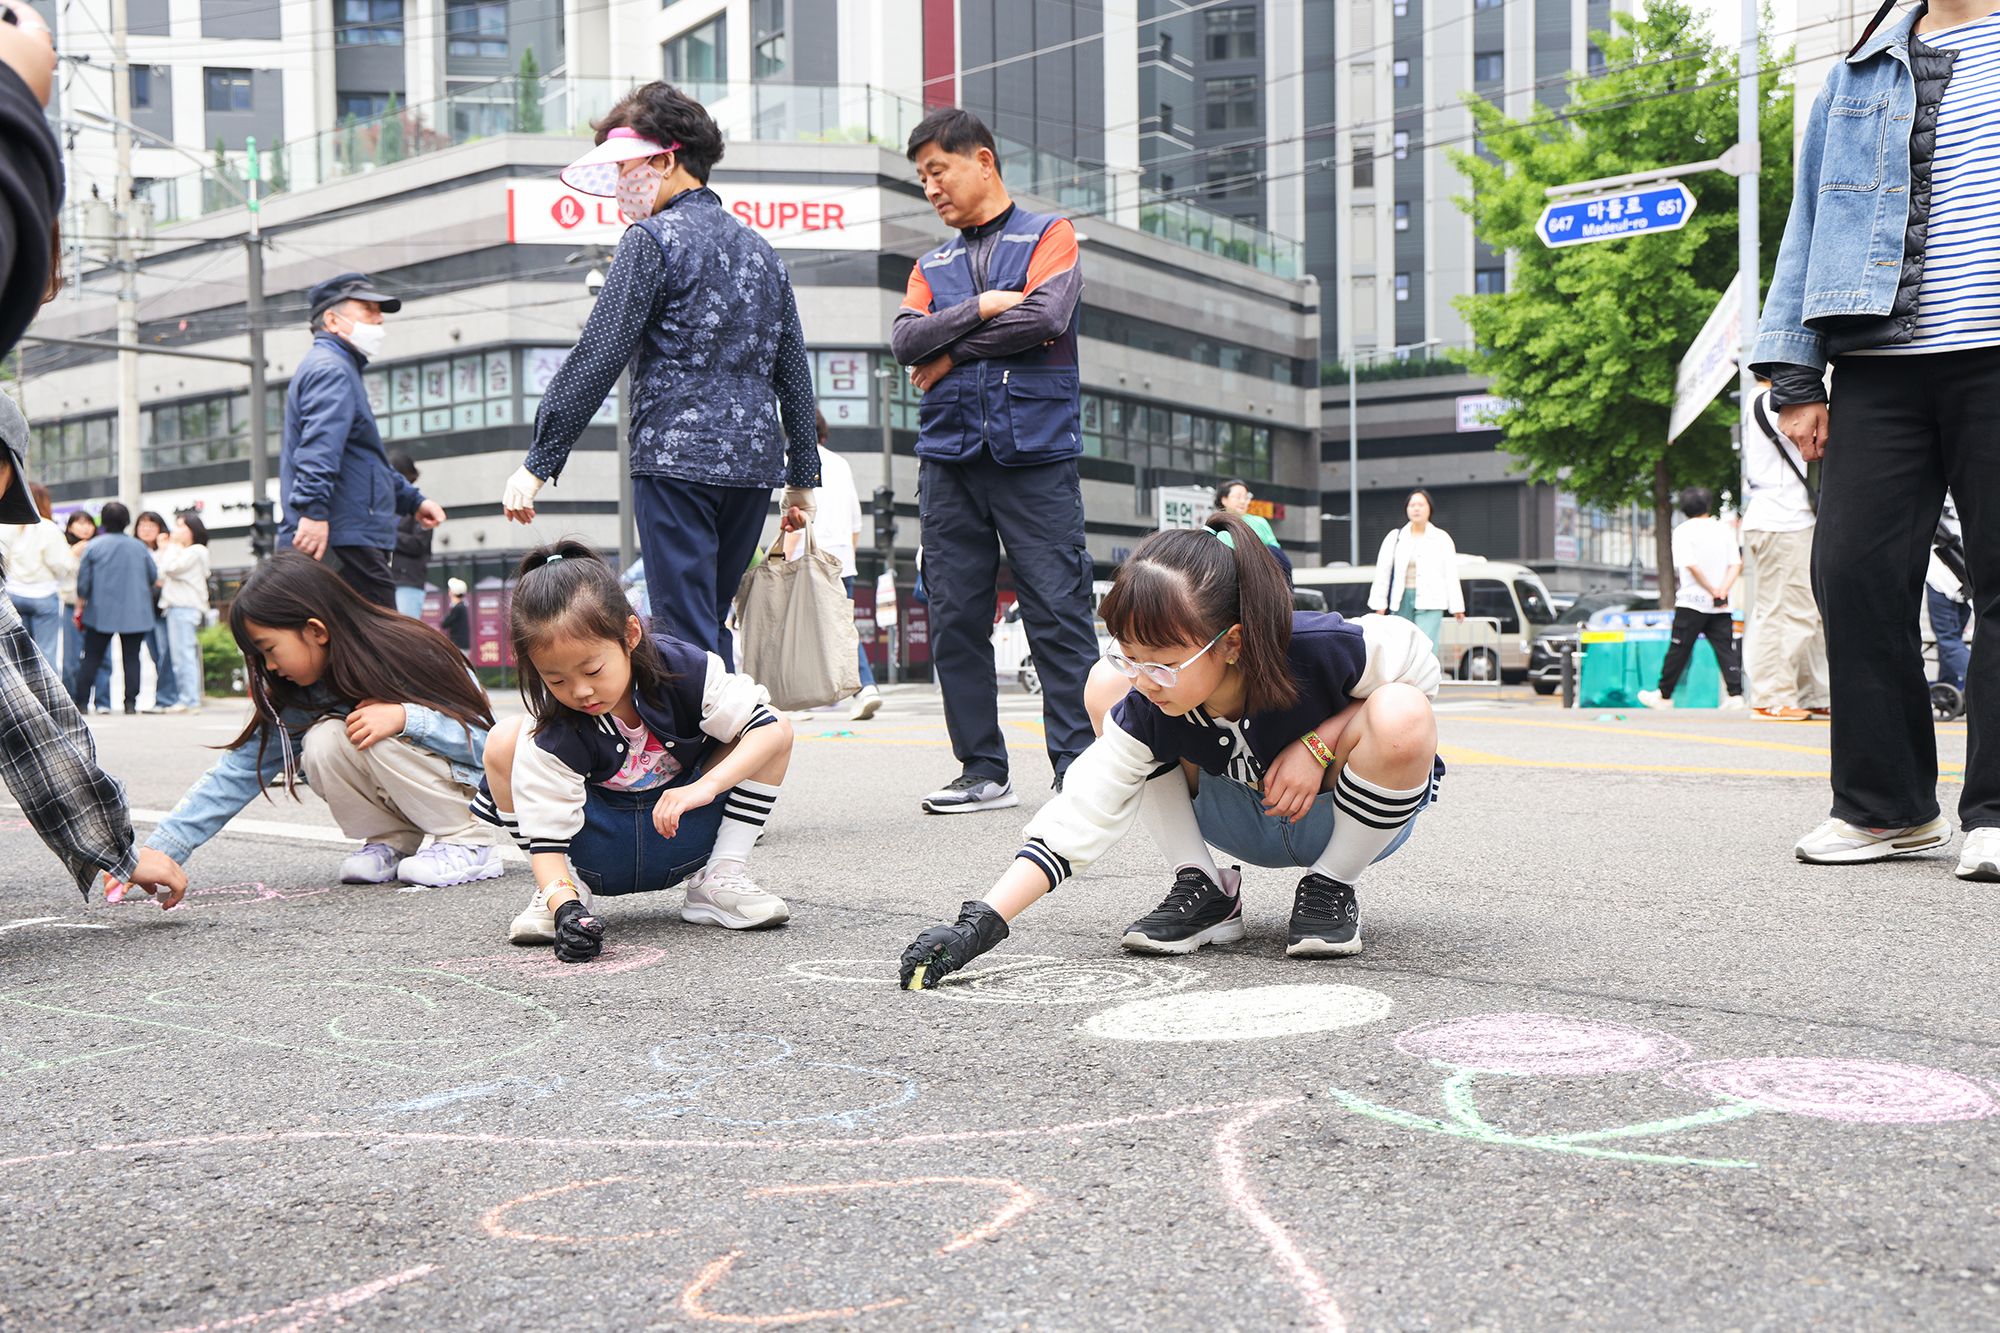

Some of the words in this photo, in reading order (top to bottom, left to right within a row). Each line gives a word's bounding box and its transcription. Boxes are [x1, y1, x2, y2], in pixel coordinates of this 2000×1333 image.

[733, 200, 845, 230] SUPER
[1549, 215, 1574, 233] 647
[1587, 196, 1643, 221] 마들로
[1656, 197, 1683, 217] 651
[1582, 217, 1649, 237] Madeul-ro
